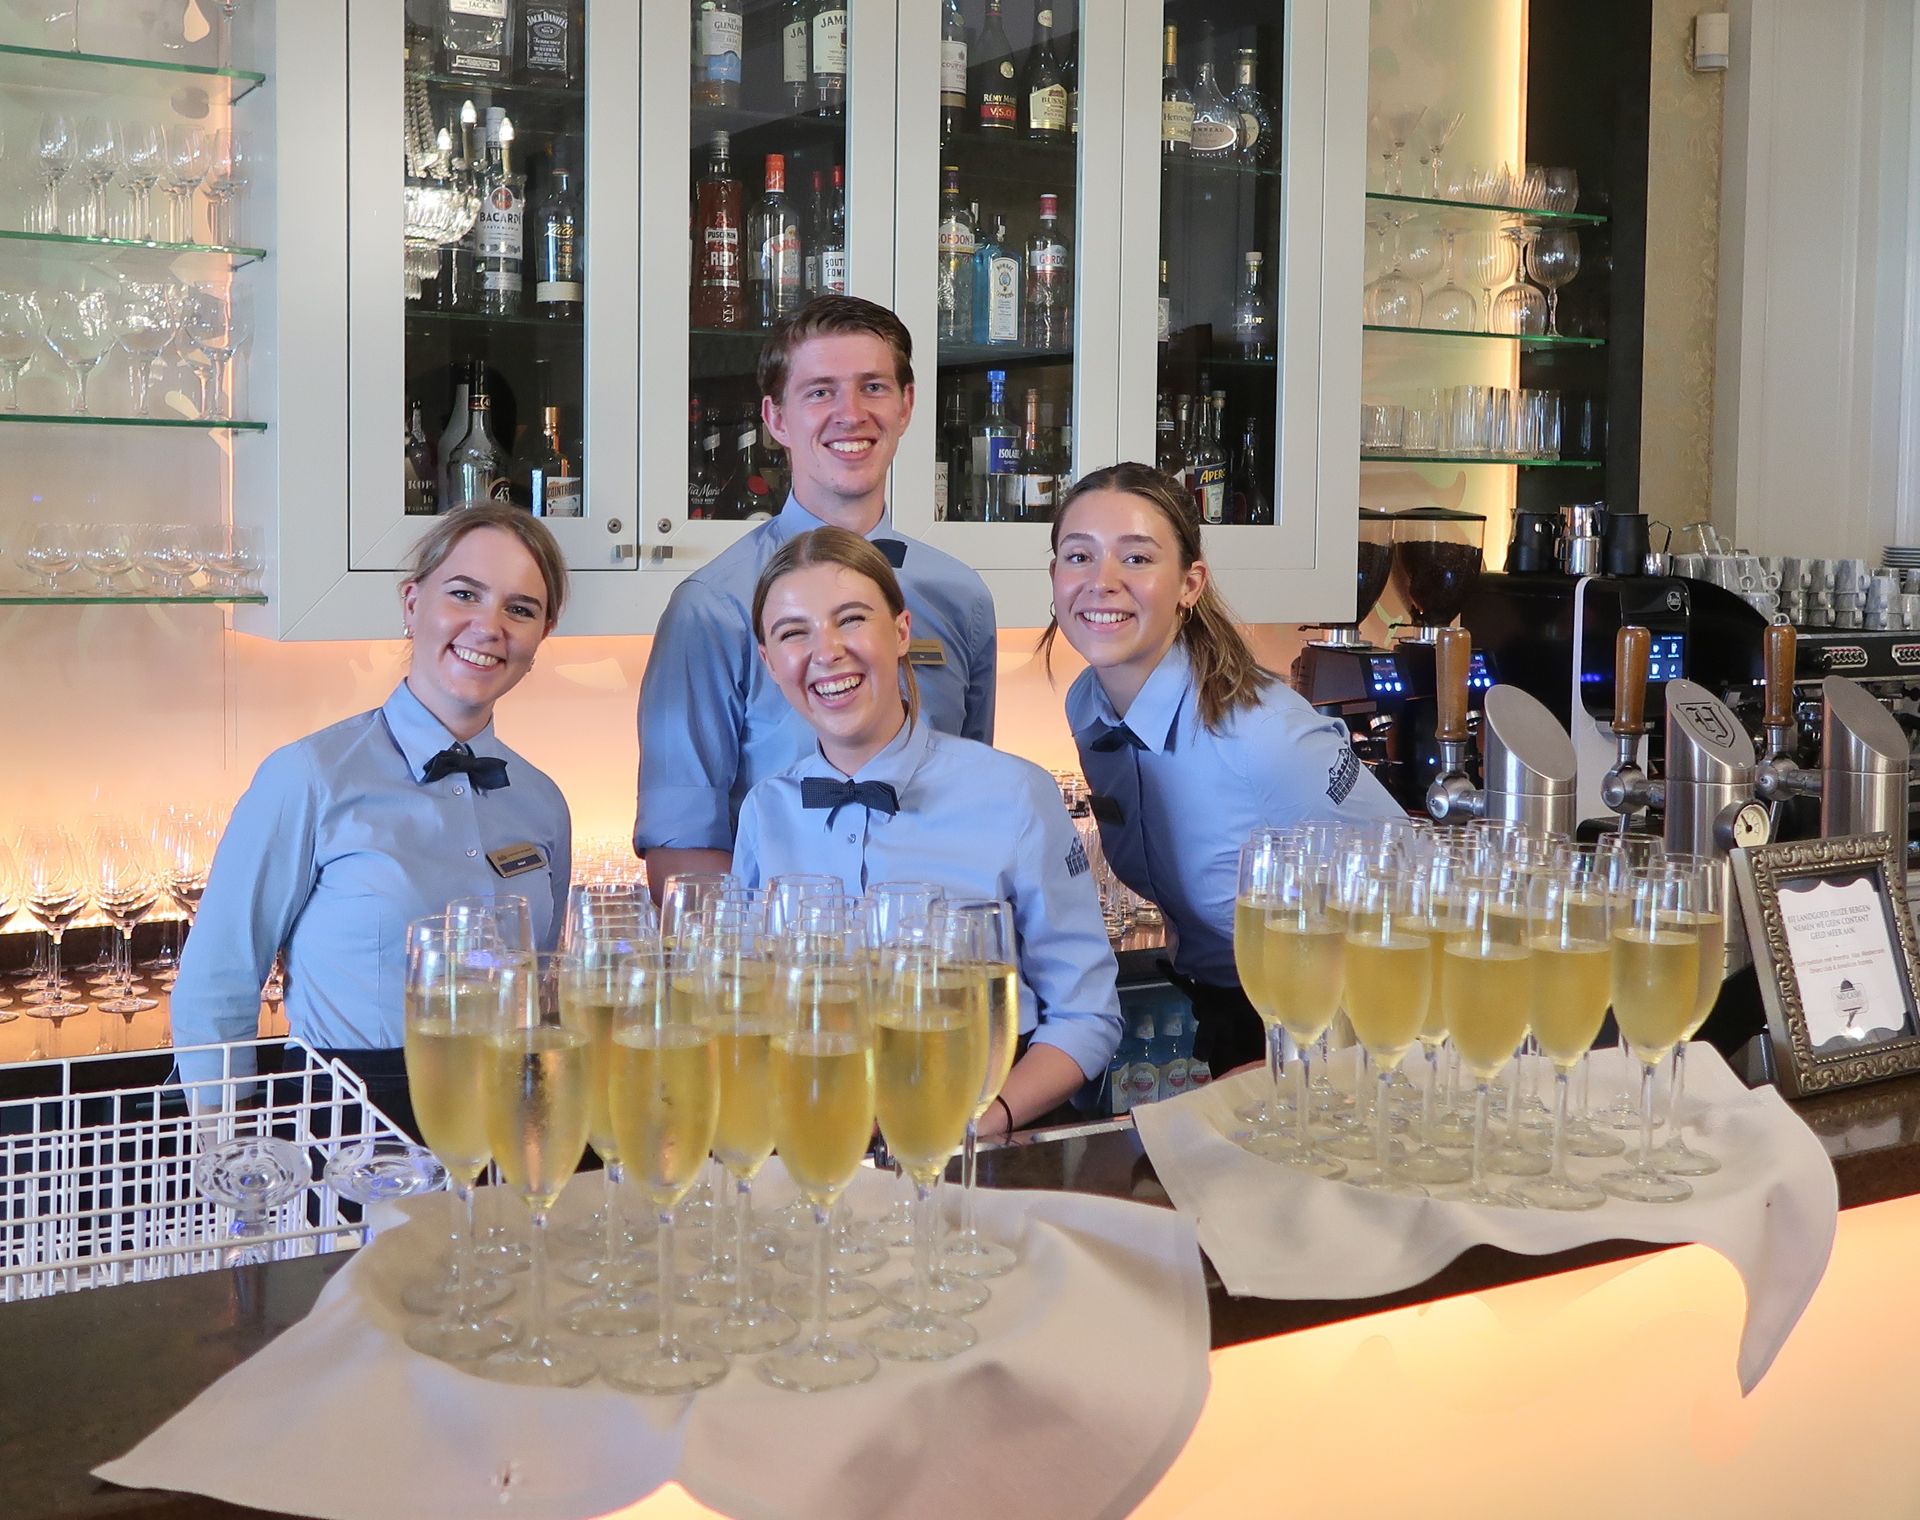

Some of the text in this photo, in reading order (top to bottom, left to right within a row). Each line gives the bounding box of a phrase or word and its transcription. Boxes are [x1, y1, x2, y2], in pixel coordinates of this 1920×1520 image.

[526, 14, 544, 26] JACK
[707, 231, 736, 239] PUSCKIN
[710, 251, 734, 266] RED
[408, 480, 435, 489] KOP
[495, 487, 510, 504] 43
[1841, 914, 1870, 925] CONTANT
